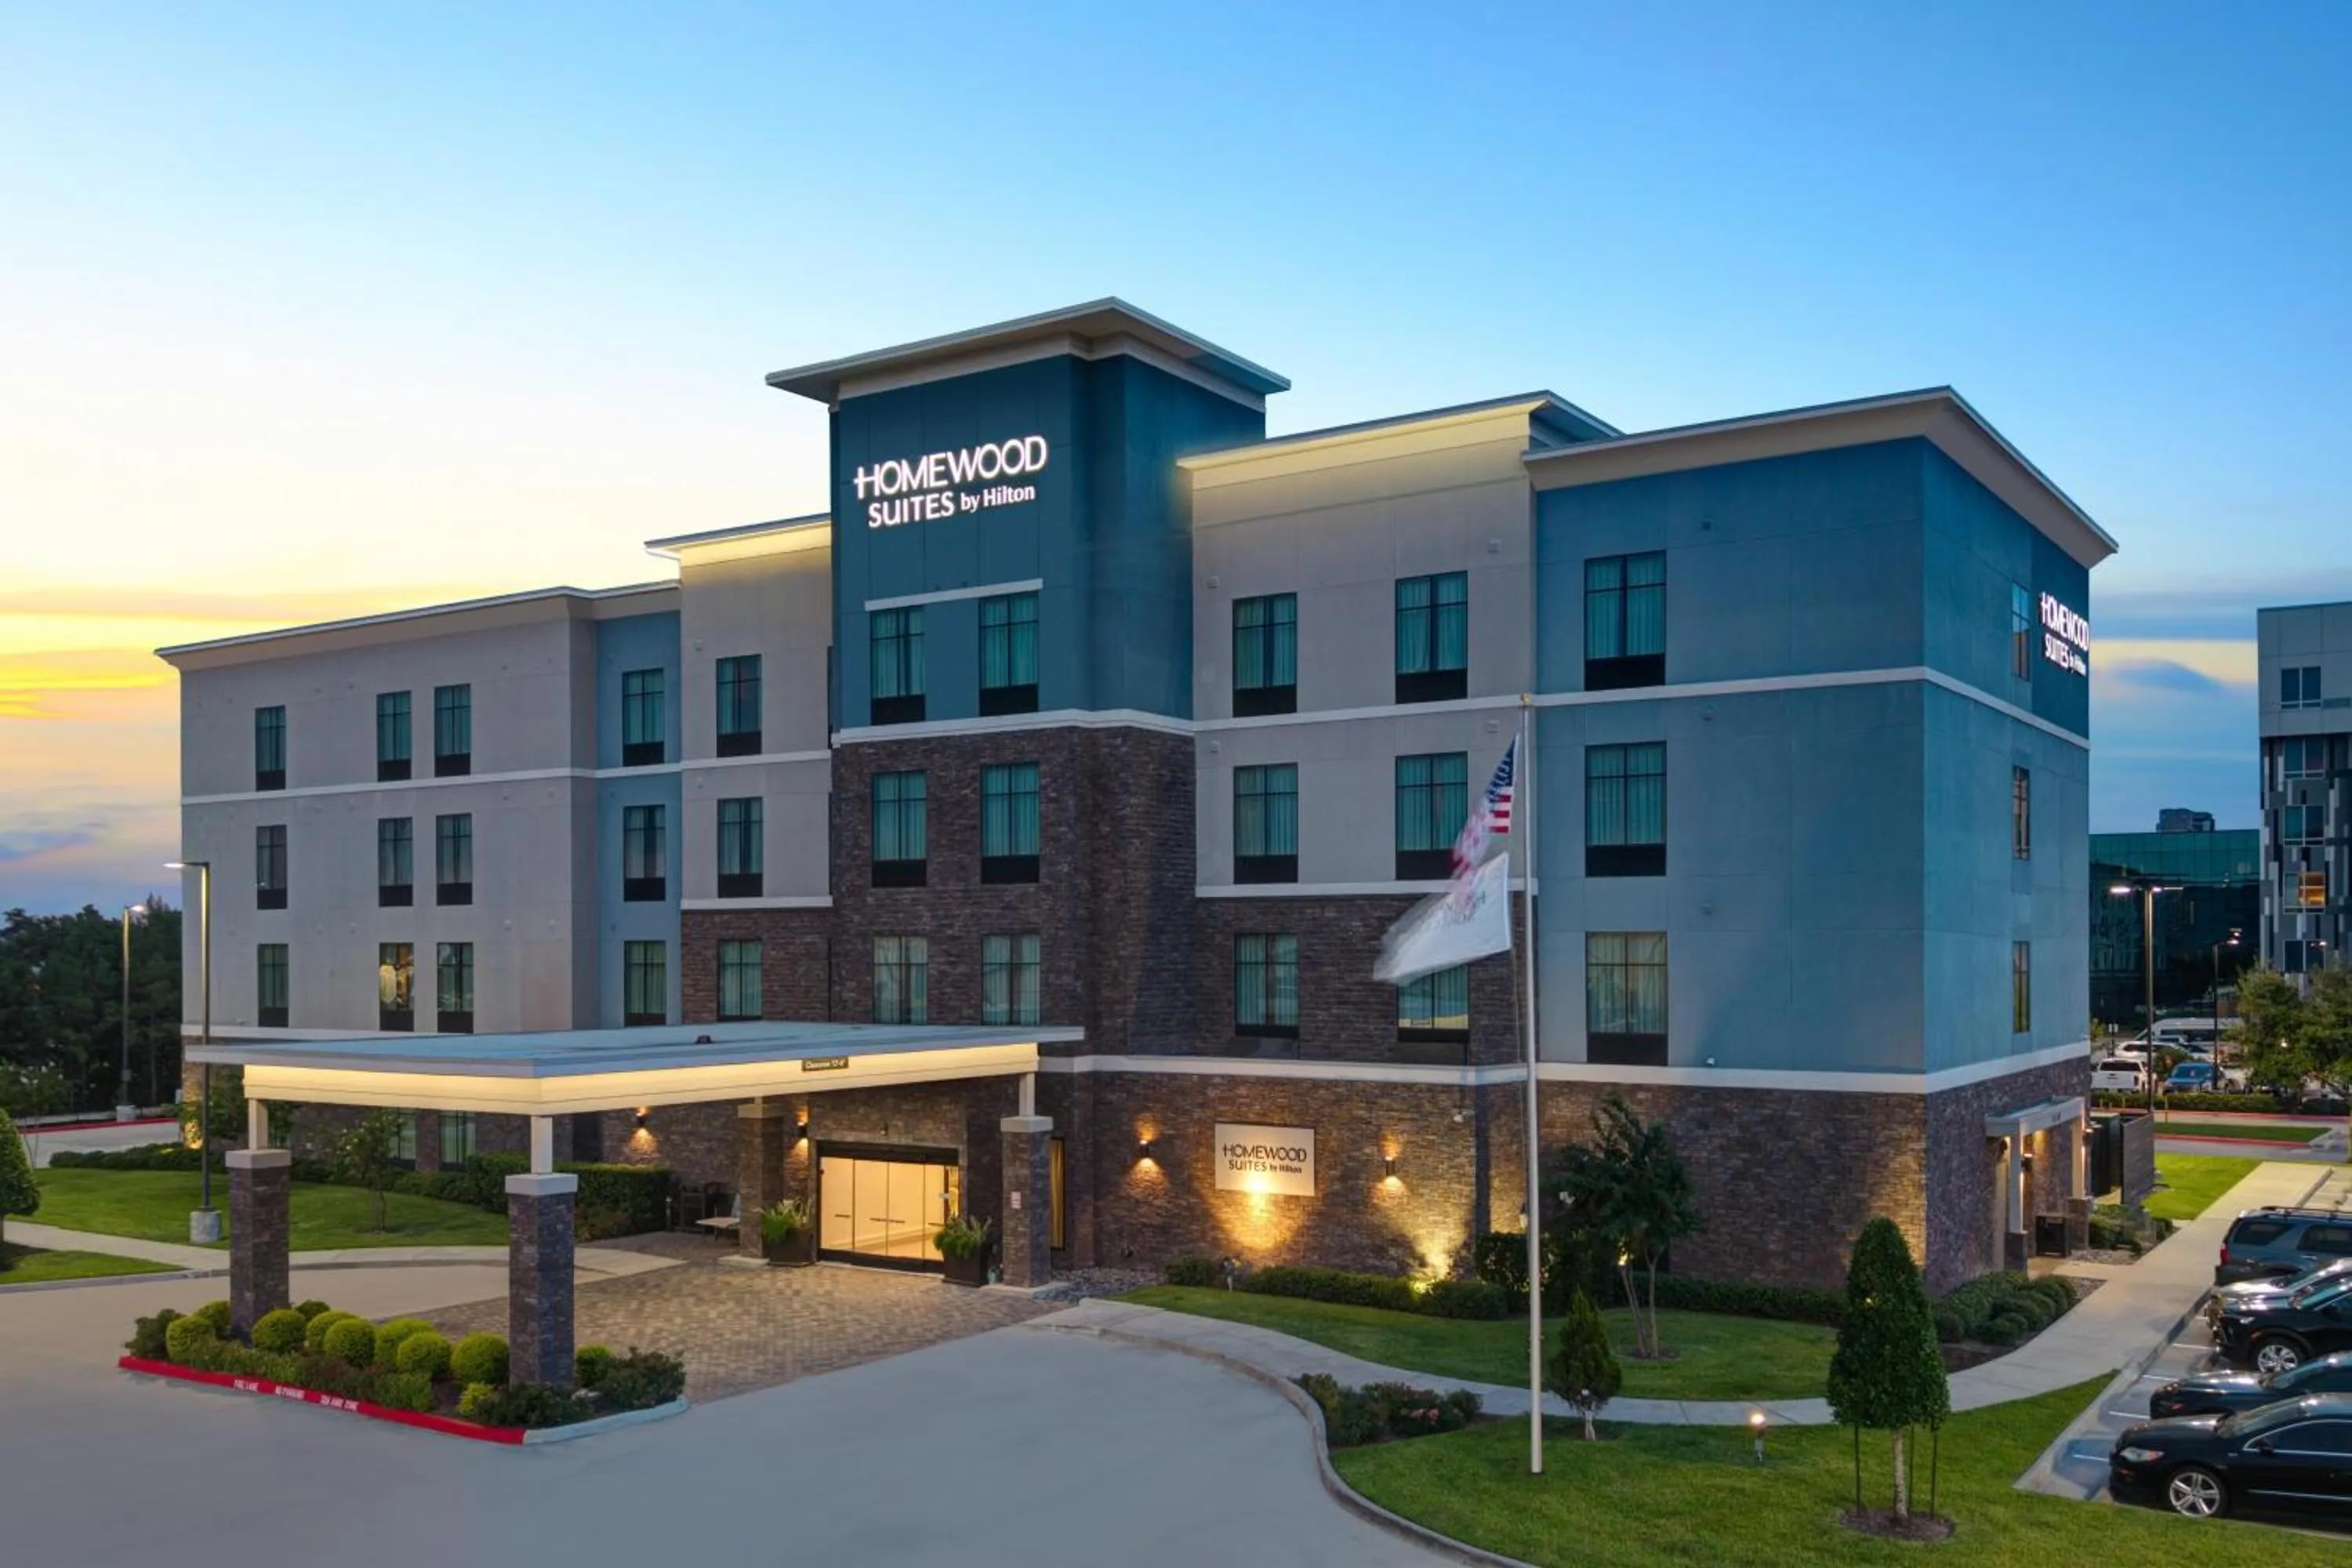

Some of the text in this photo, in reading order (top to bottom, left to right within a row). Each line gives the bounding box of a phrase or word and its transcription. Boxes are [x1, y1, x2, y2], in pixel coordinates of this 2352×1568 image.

[854, 434, 1047, 500] HOMEWOOD
[868, 485, 1036, 528] SUITES by Hilton
[2041, 591, 2089, 652] HOMEWOOD
[1223, 1143, 1307, 1162] HOMEWOOD
[1229, 1159, 1267, 1172] SUITES
[1269, 1163, 1277, 1172] by
